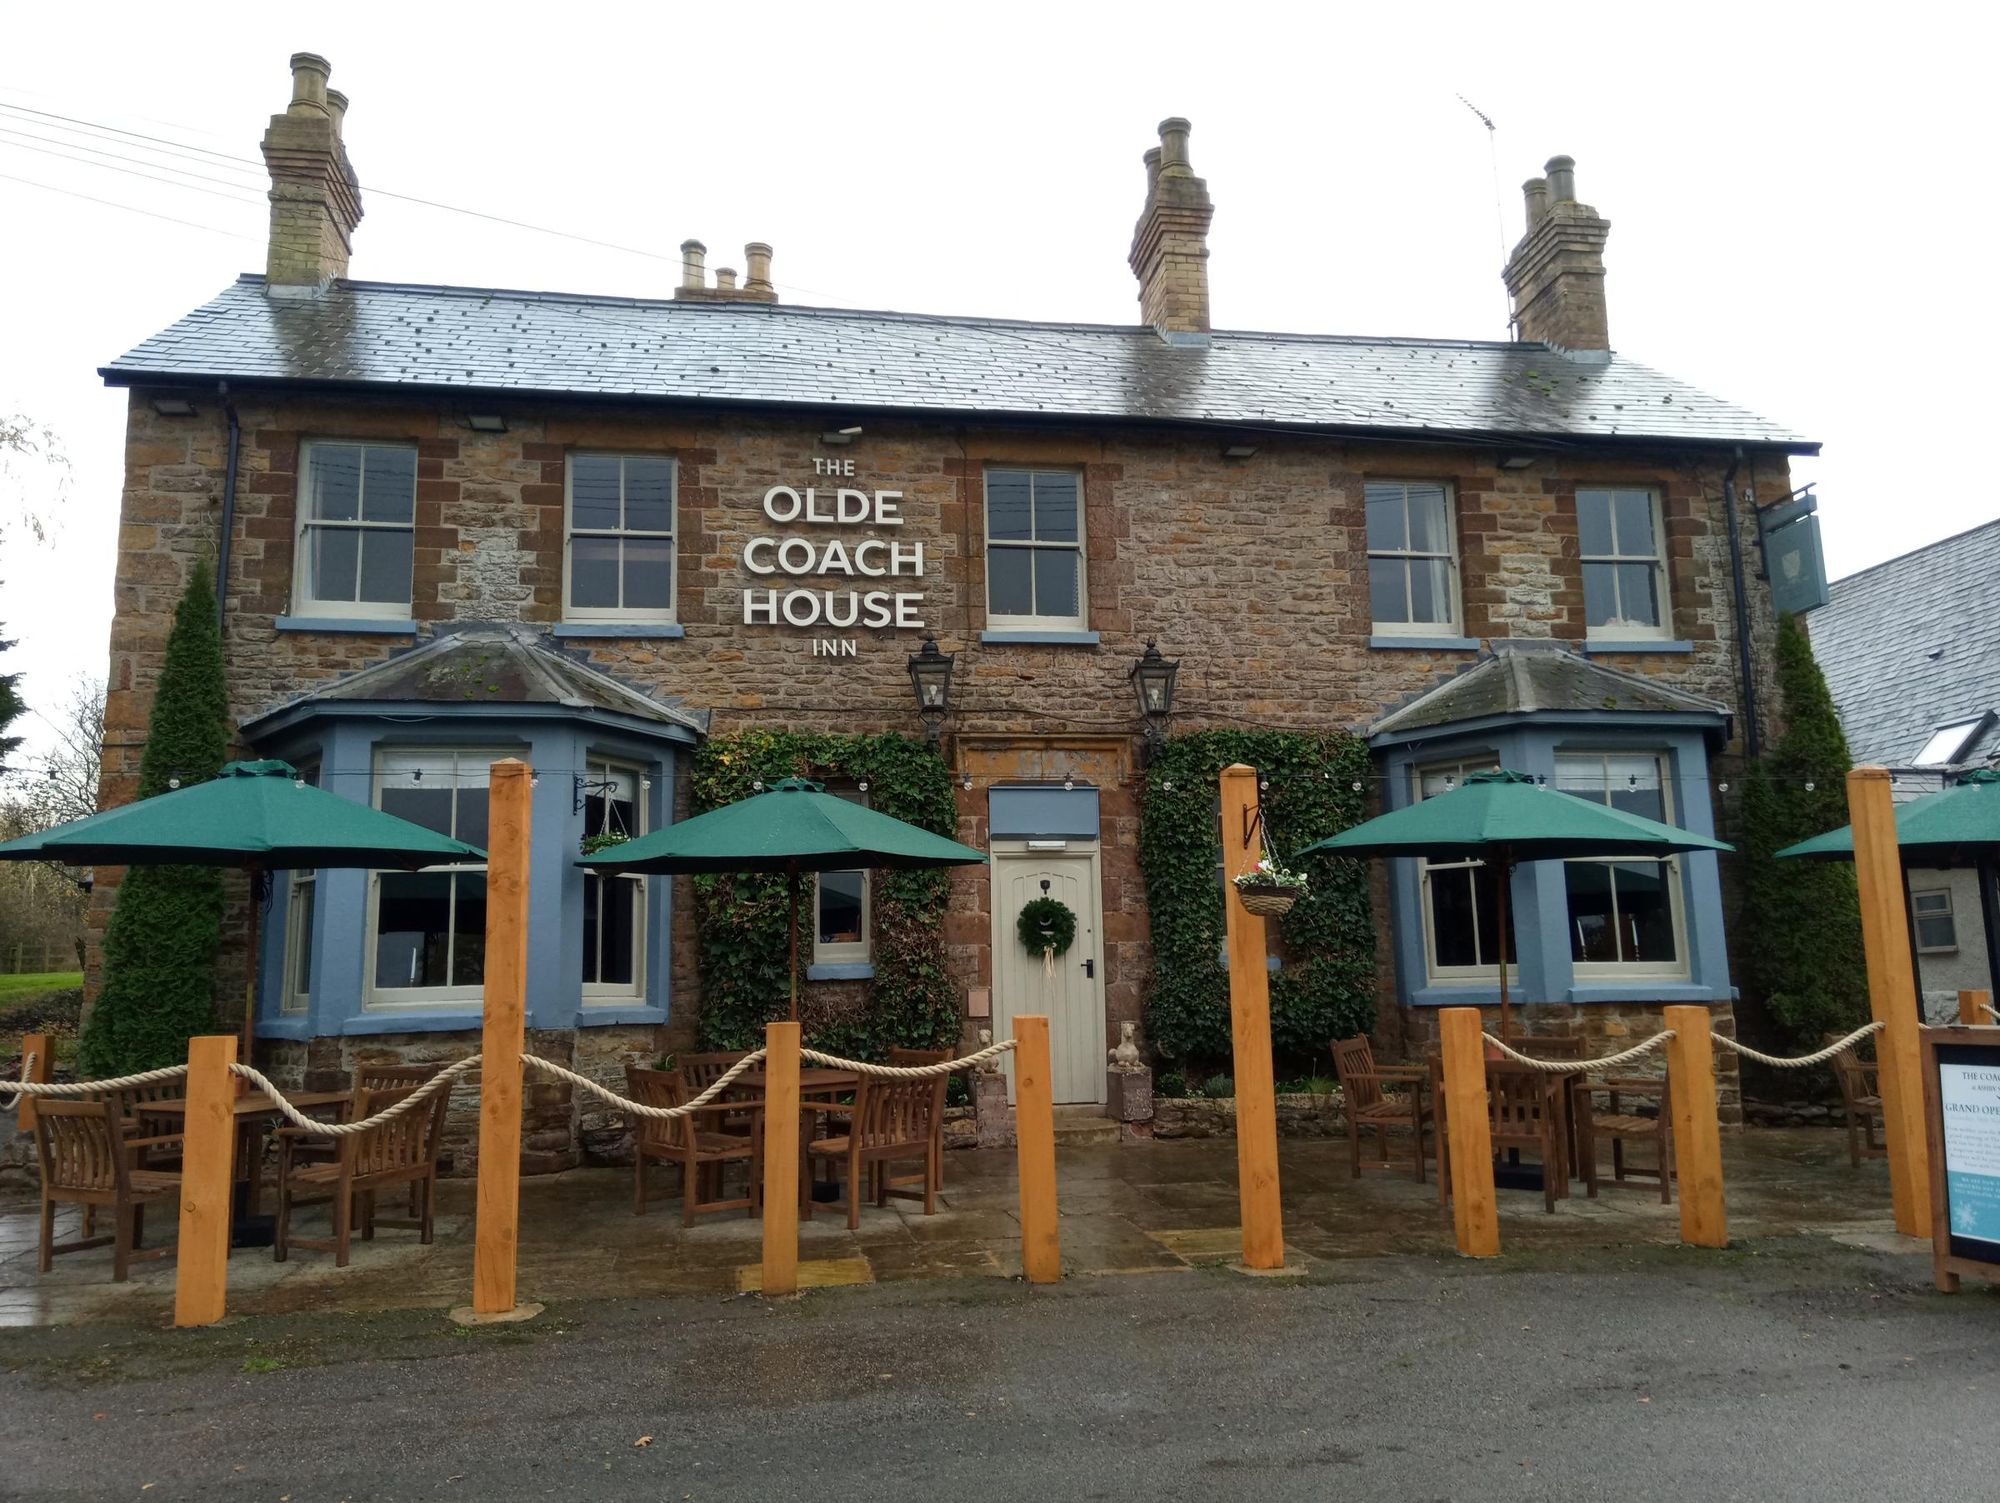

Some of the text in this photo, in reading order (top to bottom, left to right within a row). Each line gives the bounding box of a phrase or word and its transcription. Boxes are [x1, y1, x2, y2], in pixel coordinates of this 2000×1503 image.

[812, 458, 855, 477] THE
[763, 485, 904, 525] OLDE
[743, 537, 924, 577] COACH
[743, 588, 925, 628] HOUSE
[812, 638, 857, 657] INN
[1961, 1071, 1978, 1080] THE
[1944, 1103, 1980, 1113] GRAND
